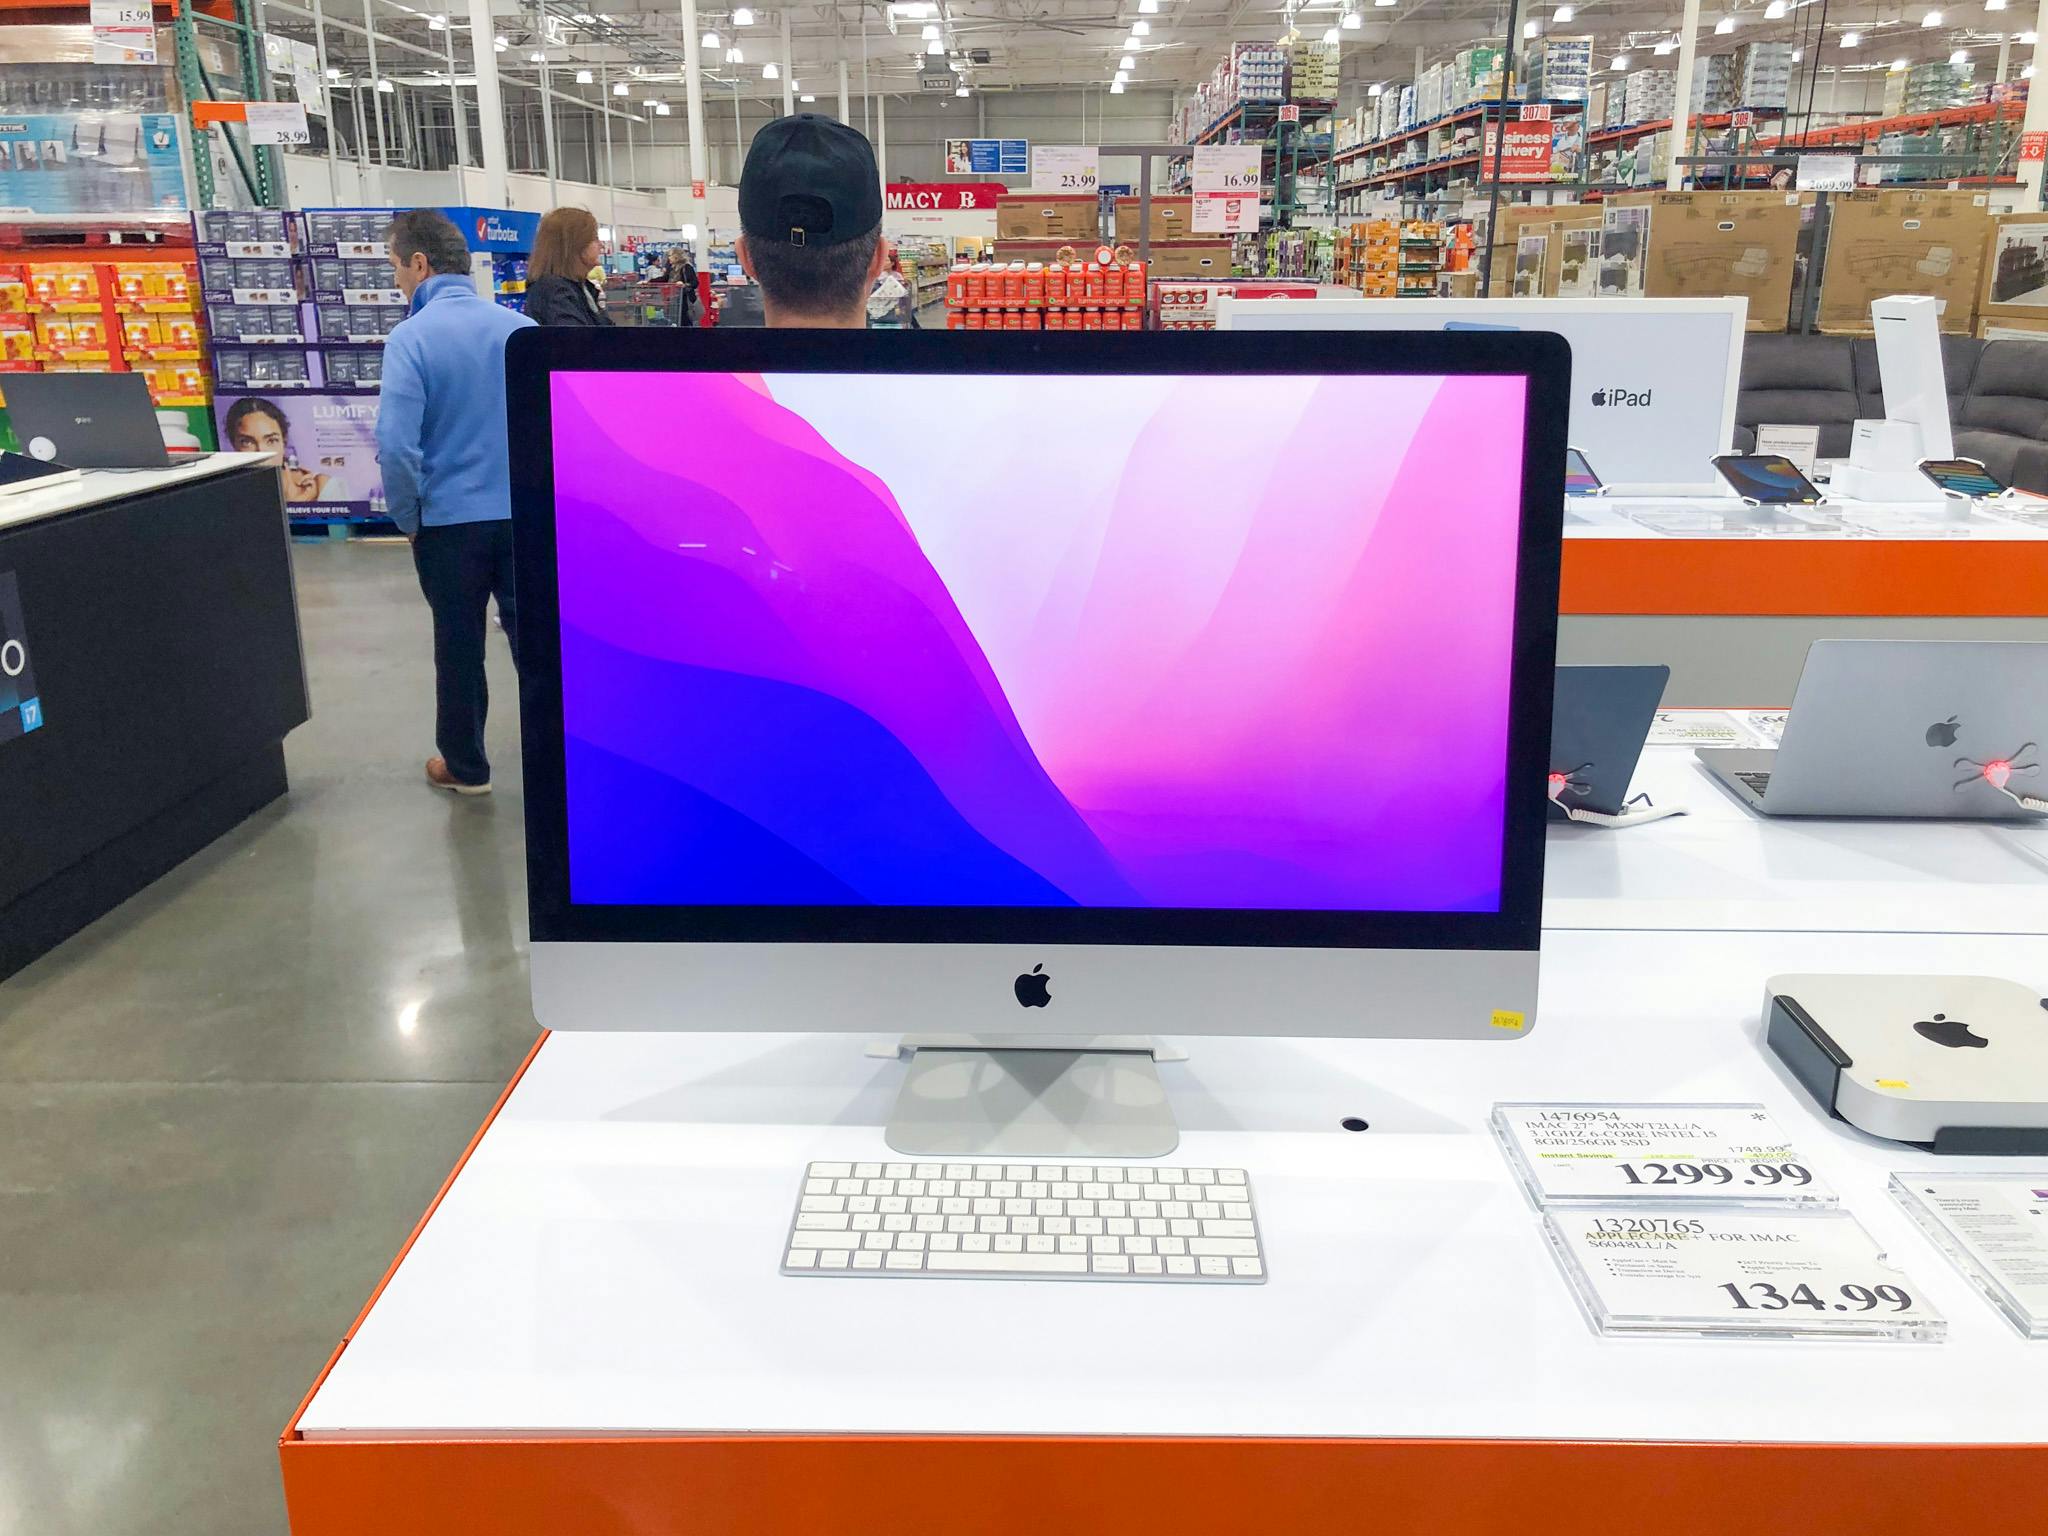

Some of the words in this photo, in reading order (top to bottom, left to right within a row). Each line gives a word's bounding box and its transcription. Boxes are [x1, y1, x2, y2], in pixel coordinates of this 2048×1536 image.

[120, 10, 151, 21] 15.99
[1522, 107, 1538, 119] 307
[1734, 112, 1749, 125] 309
[277, 131, 308, 142] 28.99
[1485, 146, 1544, 159] Dlivery
[1061, 175, 1096, 187] 23.99
[1224, 174, 1259, 186] 16.99
[887, 192, 942, 209] MACY
[487, 224, 519, 242] turbotax
[1609, 389, 1652, 407] iPad
[312, 404, 379, 418] LUMIFY
[1540, 1112, 1621, 1121] 1476954
[1525, 1121, 1568, 1129] IMAC
[1605, 1122, 1702, 1130] MXWT2LL/A
[1529, 1130, 1584, 1138] 3.1GHZ
[1589, 1130, 1648, 1138] 6-CORE
[1650, 1130, 1700, 1138] INTEL
[1534, 1138, 1617, 1146] 8GB/256GB
[1620, 1138, 1651, 1146] SSD
[1616, 1163, 1812, 1187] 1299.99
[1592, 1218, 1705, 1234] 1320765
[1708, 1233, 1746, 1241] FOR
[1748, 1233, 1801, 1242] IMAC
[1588, 1240, 1678, 1249] S6048LL/A
[1717, 1282, 1912, 1312] 134.99
